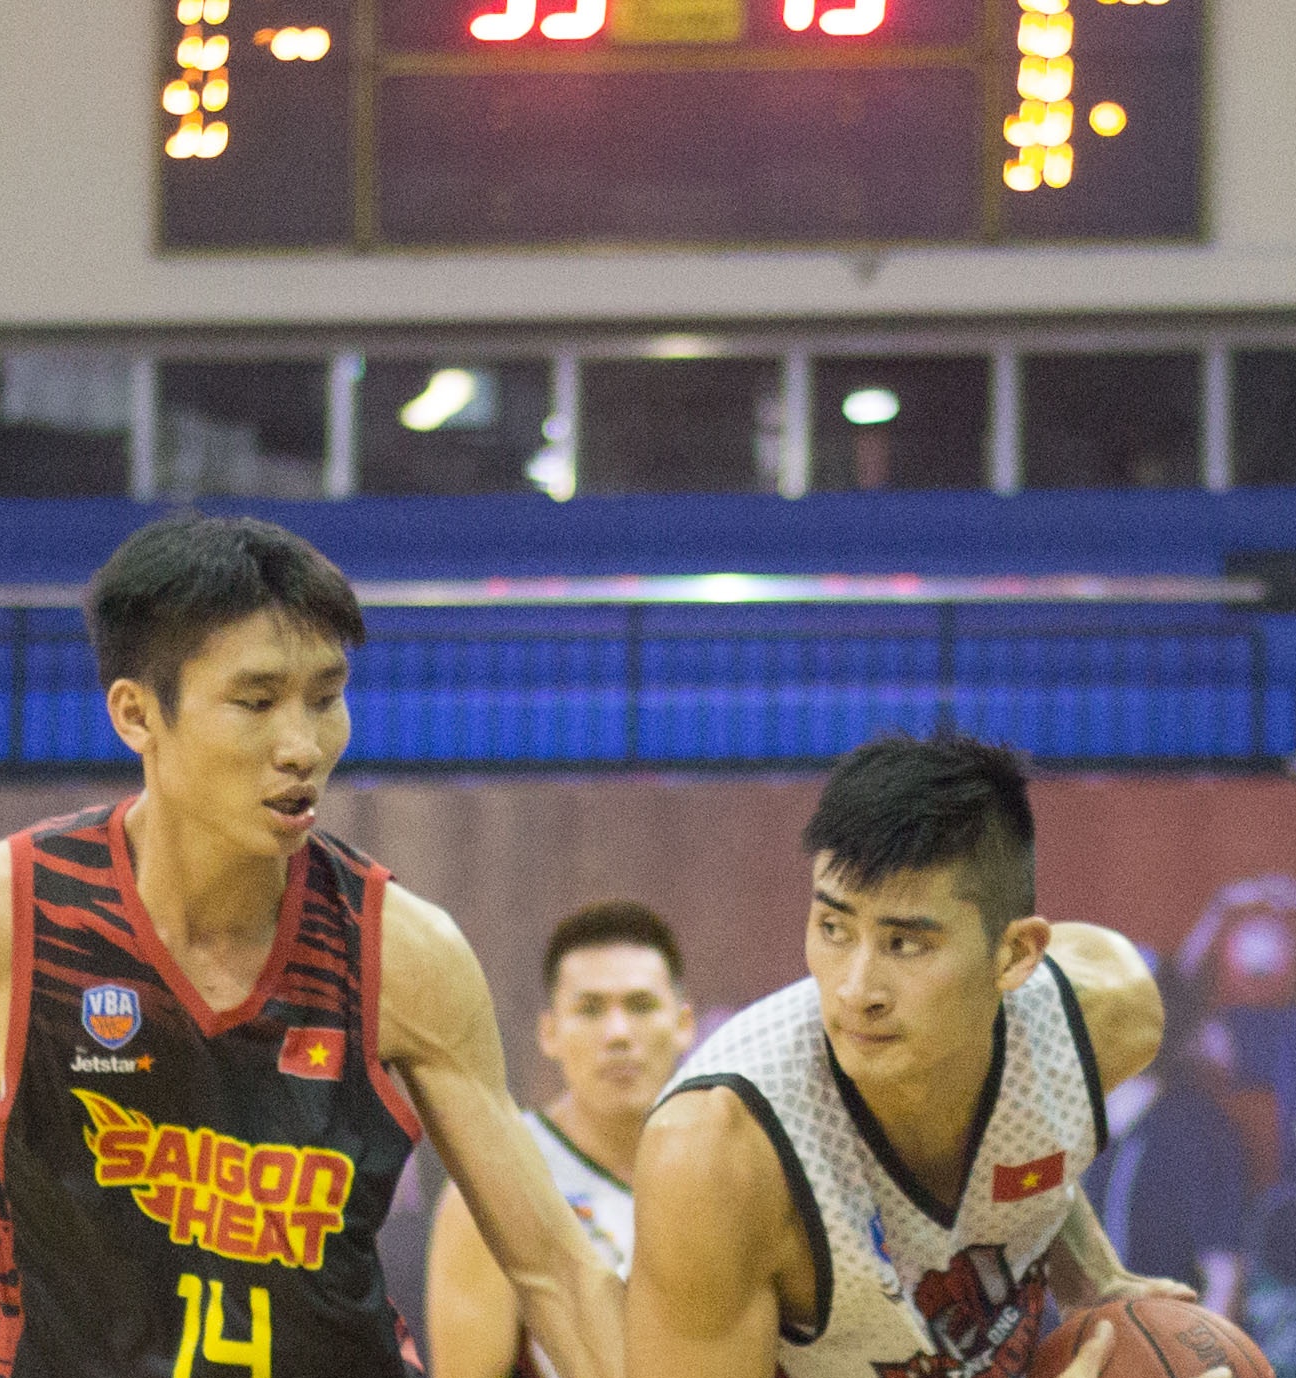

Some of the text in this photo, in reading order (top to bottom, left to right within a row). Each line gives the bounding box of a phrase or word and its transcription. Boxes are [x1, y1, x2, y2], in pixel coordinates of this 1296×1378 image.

[89, 991, 133, 1015] VBA
[70, 1055, 136, 1073] Jetstar
[98, 1124, 355, 1210] SAIGON
[133, 1183, 344, 1271] HEAT
